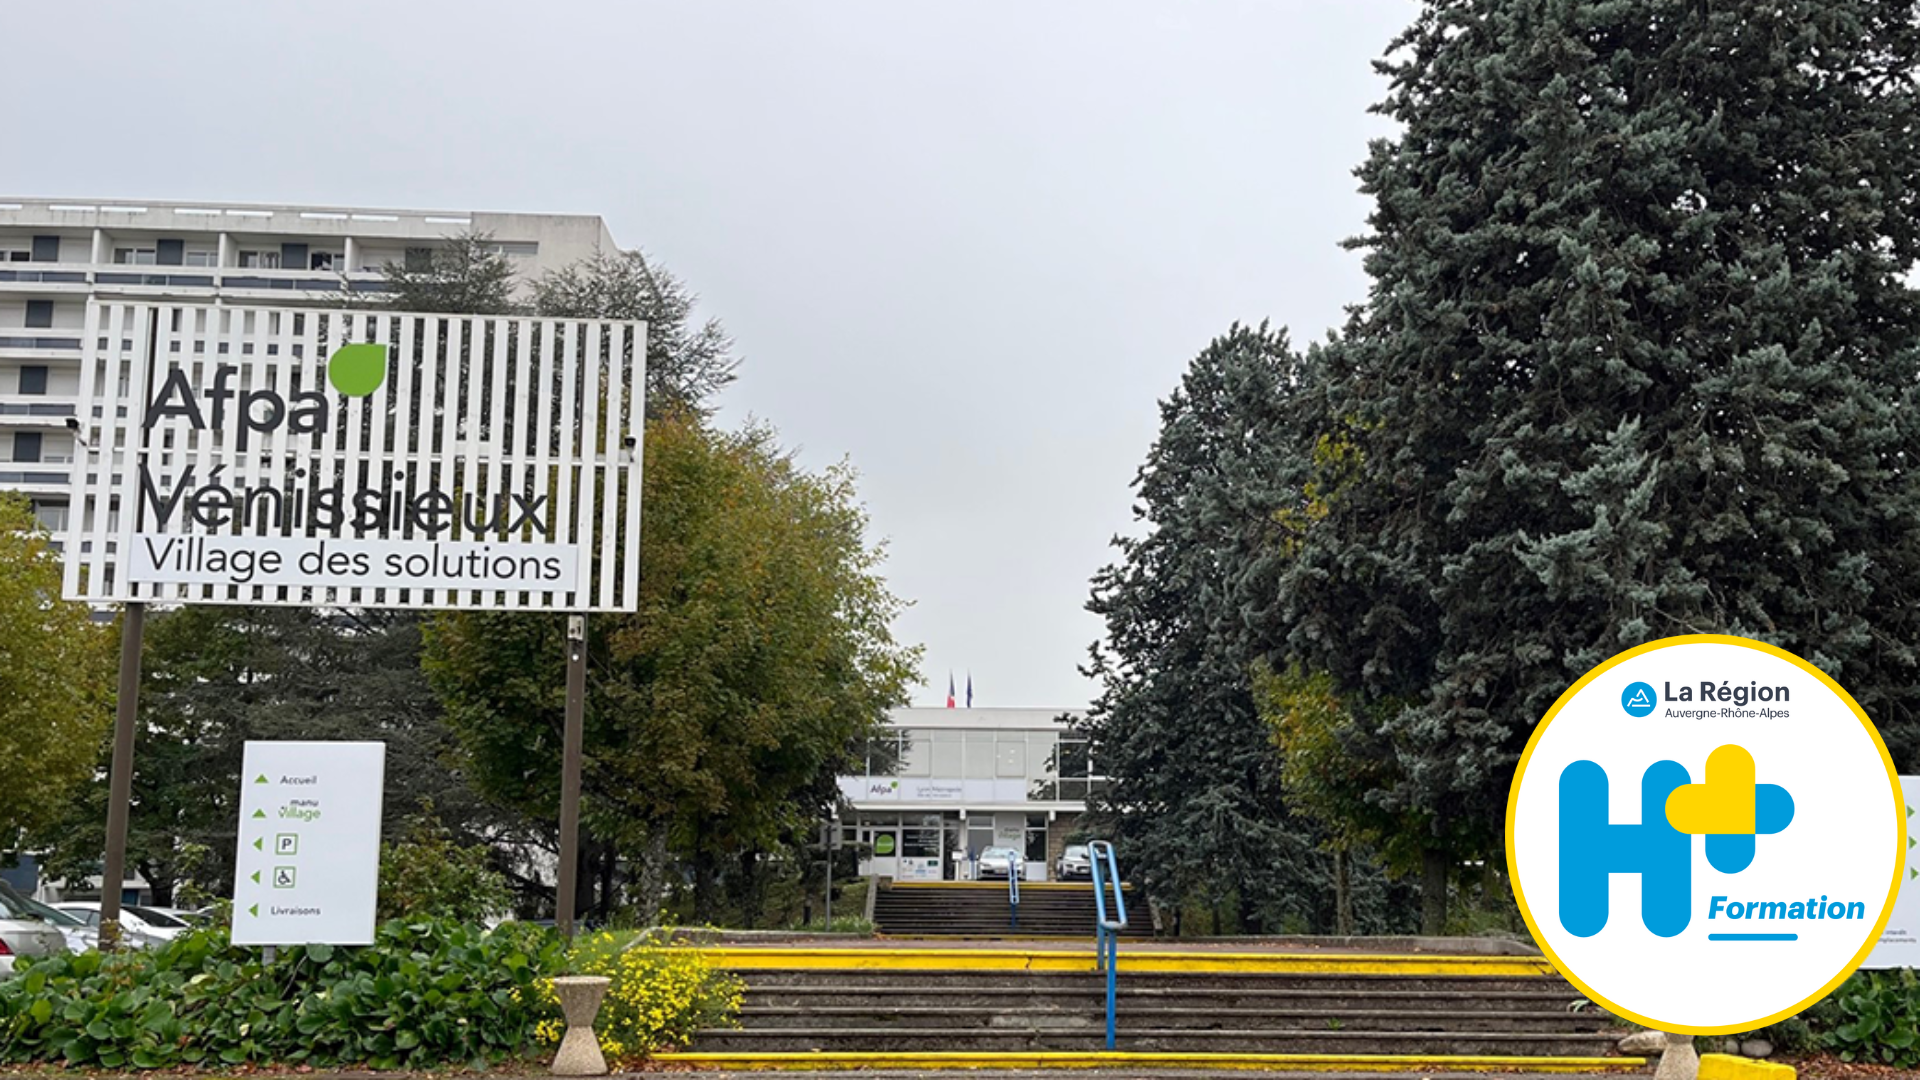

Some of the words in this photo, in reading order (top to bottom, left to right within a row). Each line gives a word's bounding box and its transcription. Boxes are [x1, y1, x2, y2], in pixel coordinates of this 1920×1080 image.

[142, 366, 329, 451] Afpa
[138, 462, 548, 535] Vénissieux
[145, 536, 281, 582] Village
[299, 541, 370, 577] des
[385, 545, 562, 581] solutions
[279, 775, 318, 785] Accueil
[870, 784, 893, 795] Afpa
[290, 799, 319, 807] manu
[281, 838, 292, 850] P
[270, 905, 321, 916] Livraisons
